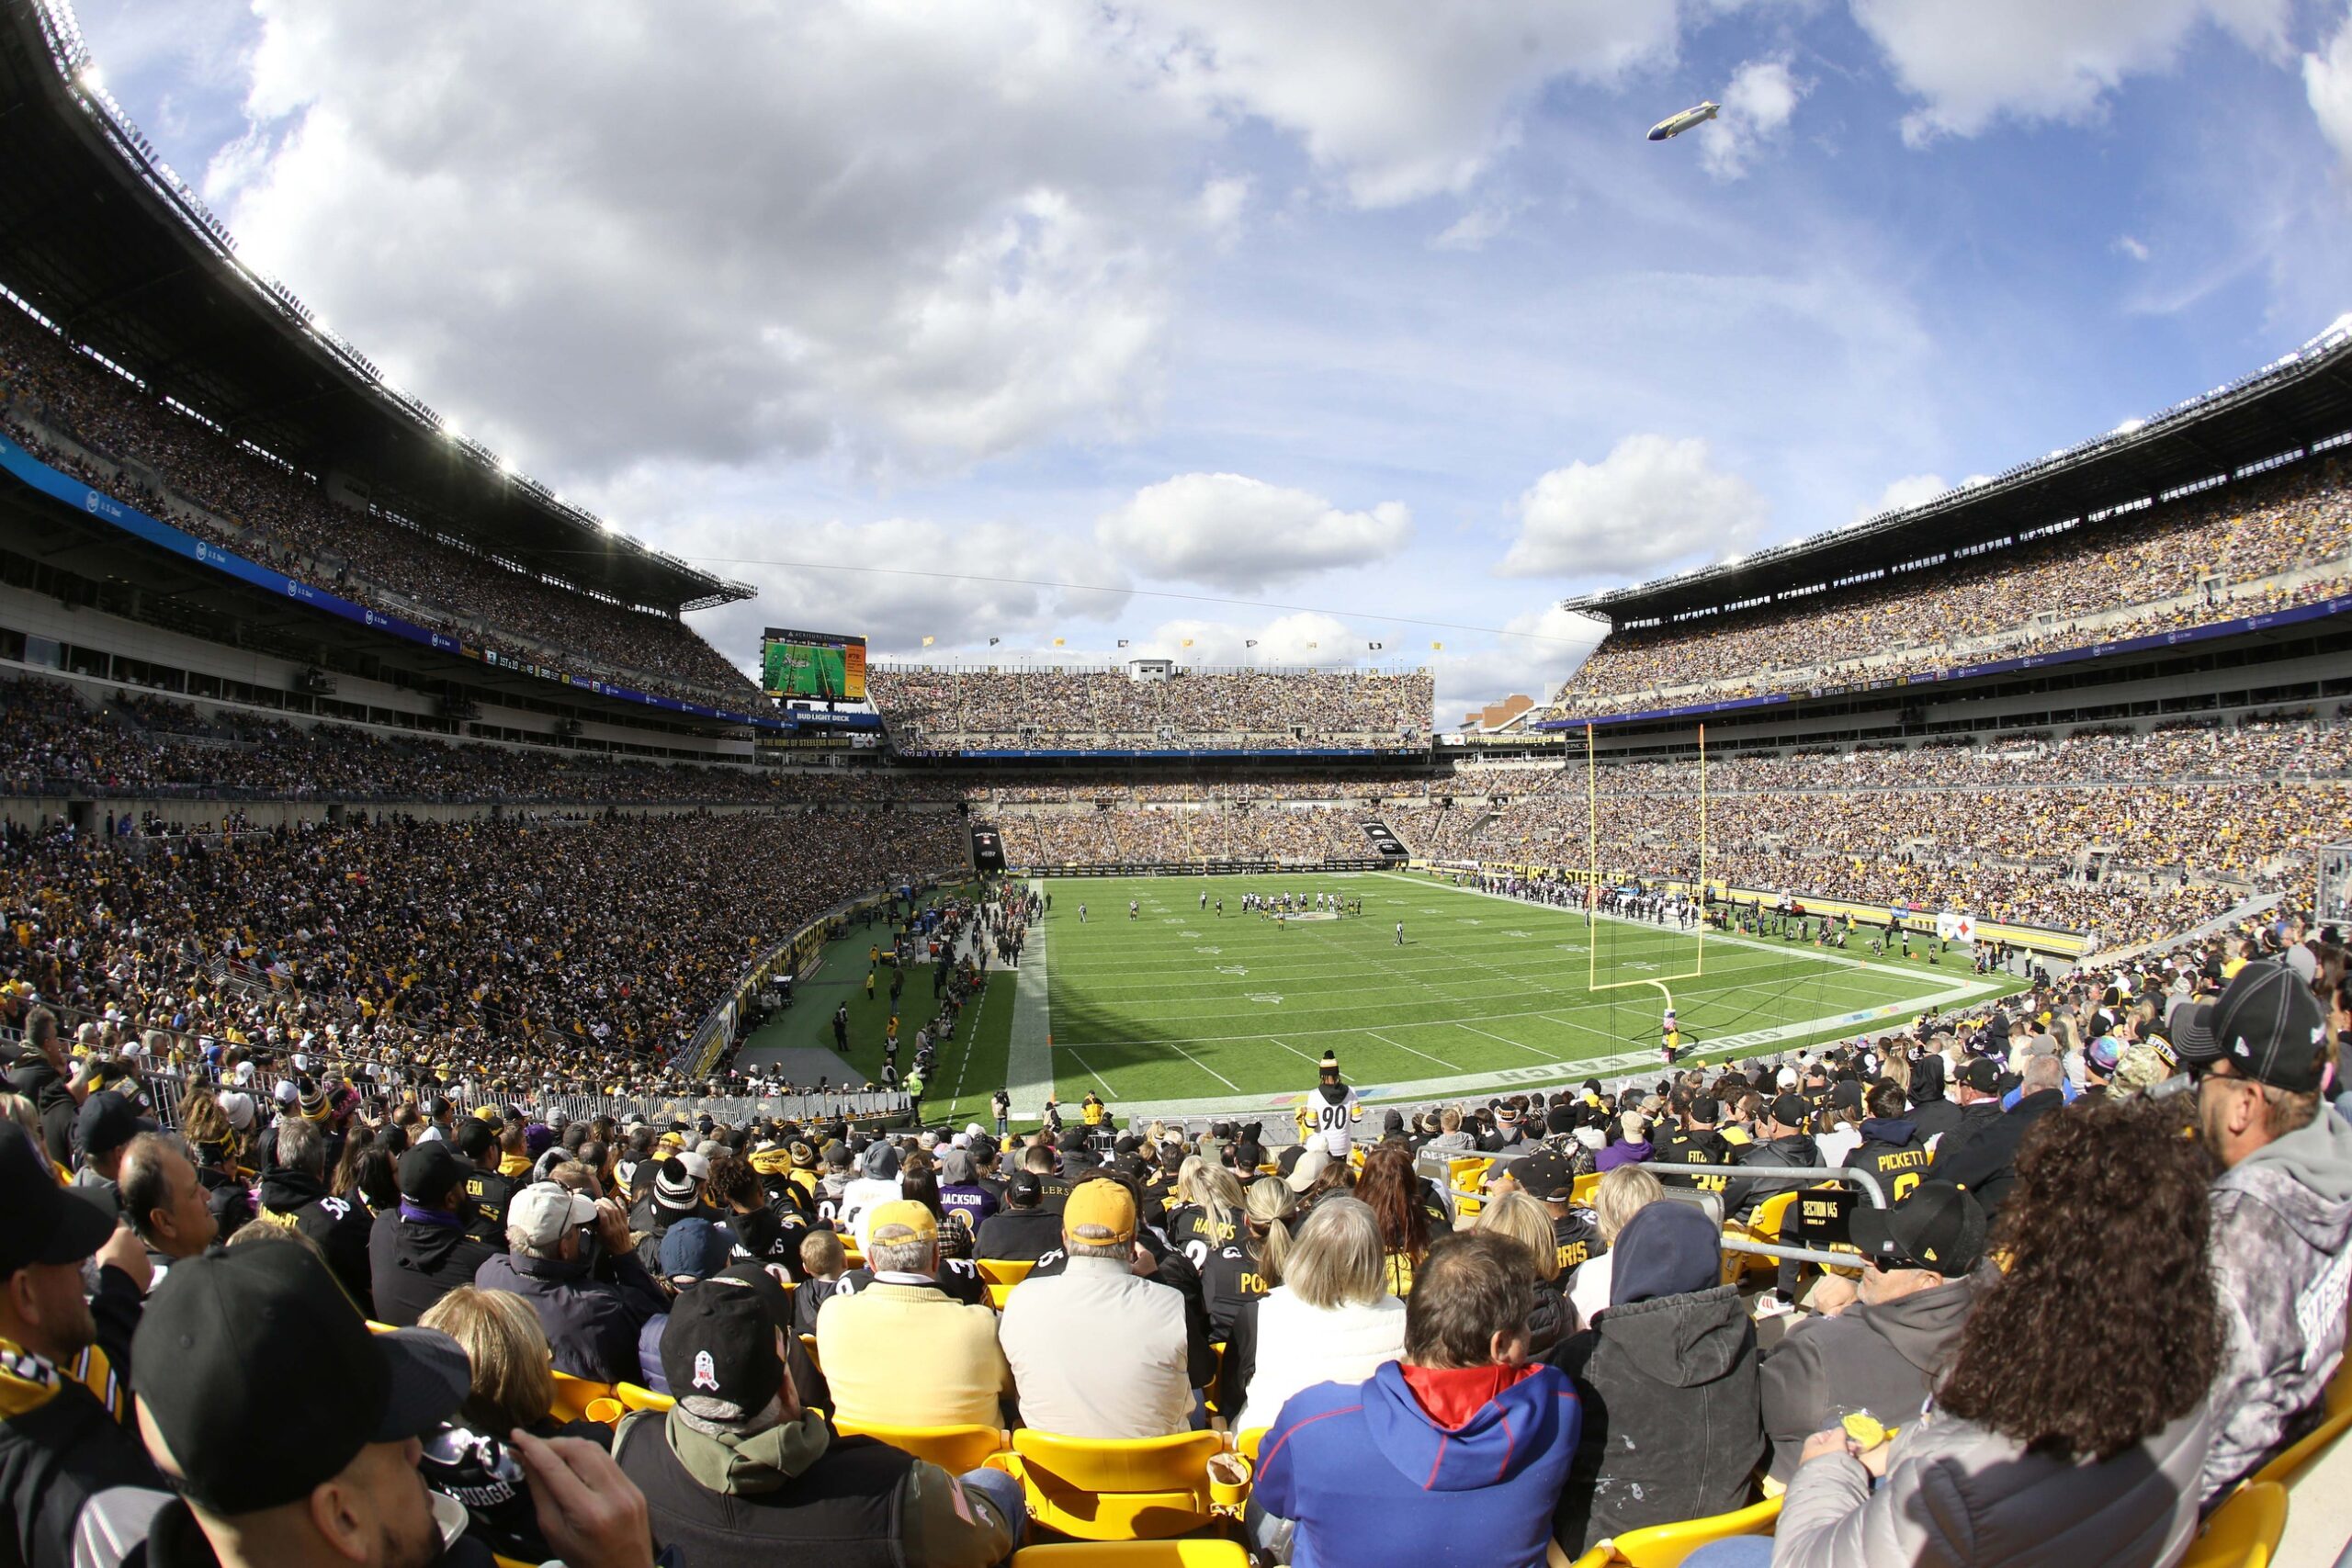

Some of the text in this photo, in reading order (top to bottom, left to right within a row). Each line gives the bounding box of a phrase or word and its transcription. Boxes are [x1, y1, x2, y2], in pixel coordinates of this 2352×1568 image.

[790, 739, 798, 747] OF
[799, 739, 827, 747] STEELERS
[828, 739, 850, 747] NATION
[1515, 736, 1552, 744] STEELERS
[1322, 1104, 1347, 1130] 90
[1877, 1150, 1924, 1172] PICKETT
[941, 1193, 982, 1206] JACKSON
[321, 1196, 351, 1221] 58
[1803, 1201, 1838, 1218] SECTION 145
